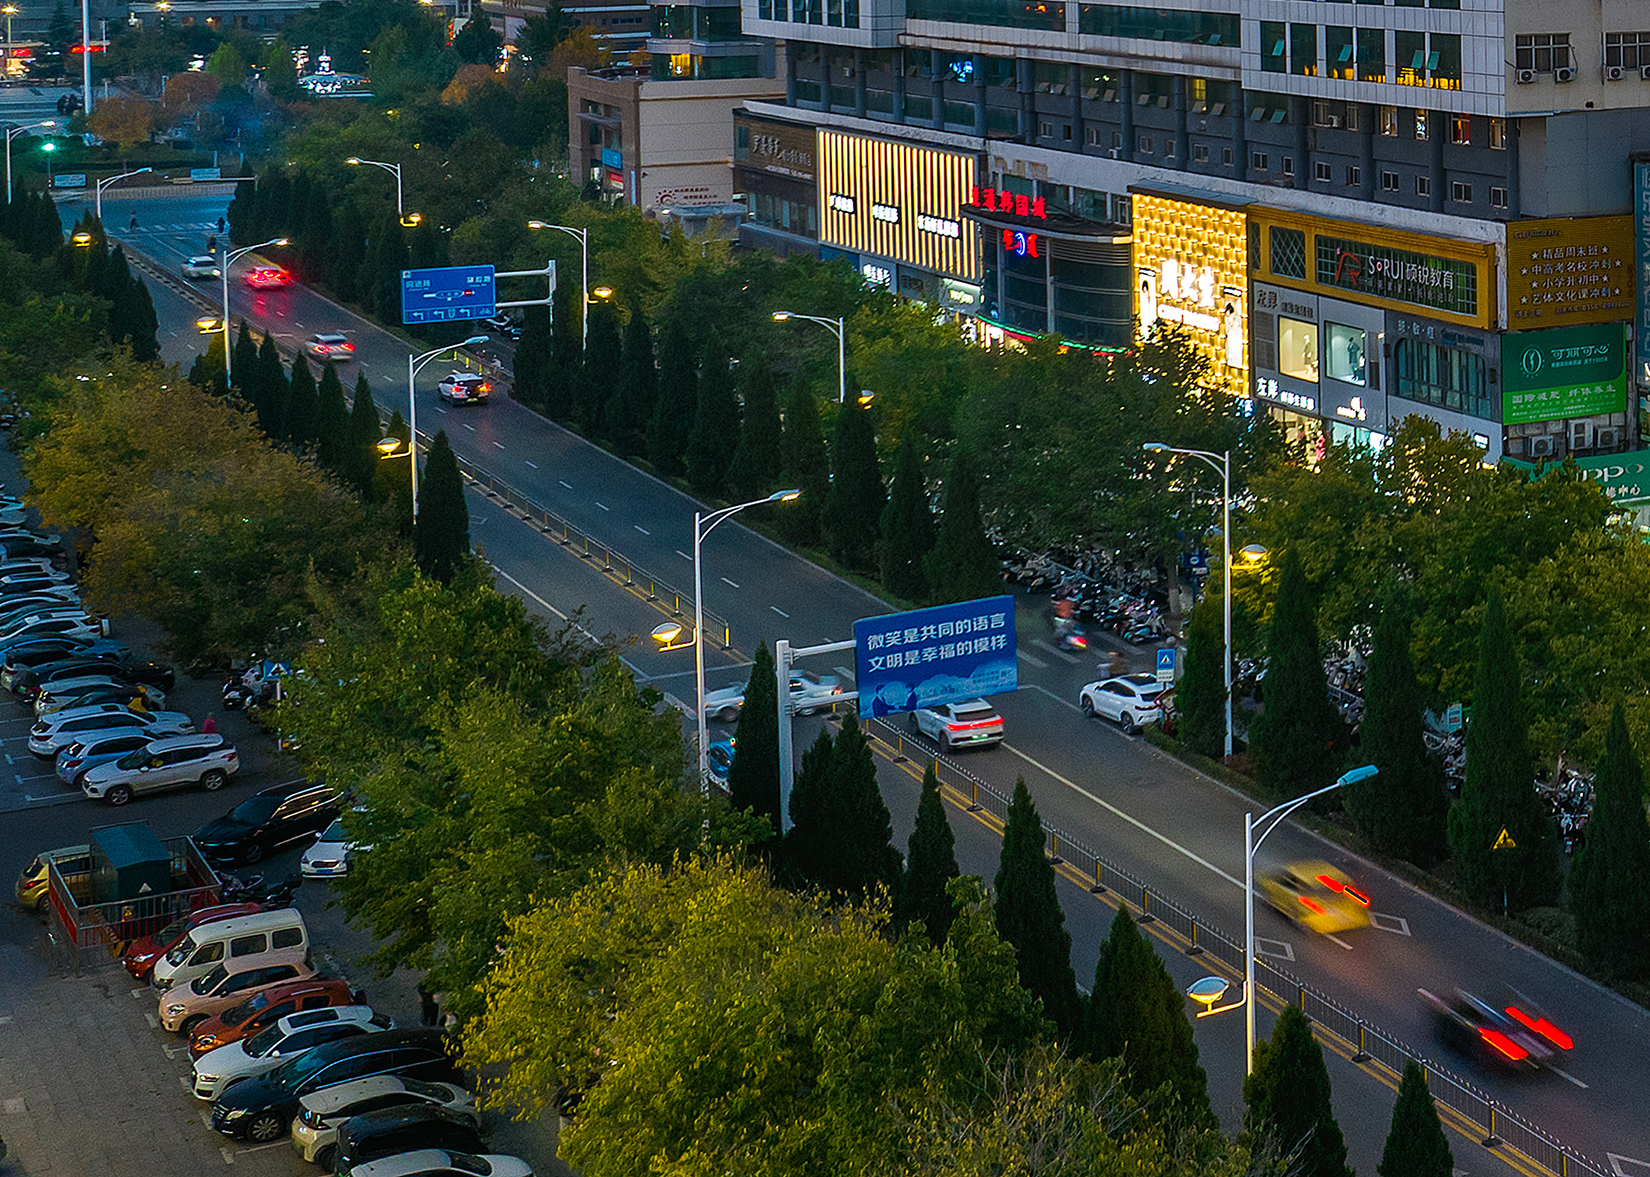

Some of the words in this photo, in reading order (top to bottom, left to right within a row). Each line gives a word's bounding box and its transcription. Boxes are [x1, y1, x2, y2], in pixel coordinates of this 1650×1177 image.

[1542, 244, 1599, 260] 精品周末班
[1531, 258, 1612, 276] 中高考名校冲刺
[1405, 263, 1455, 291] 硕锐教育
[1542, 273, 1600, 290] 小学升初中
[1532, 286, 1612, 305] 艺体文化课冲刺
[1550, 343, 1611, 360] 可丽可心
[866, 612, 1007, 651] 微笑是共同的语言
[868, 633, 1008, 673] 文明是幸福的模样
